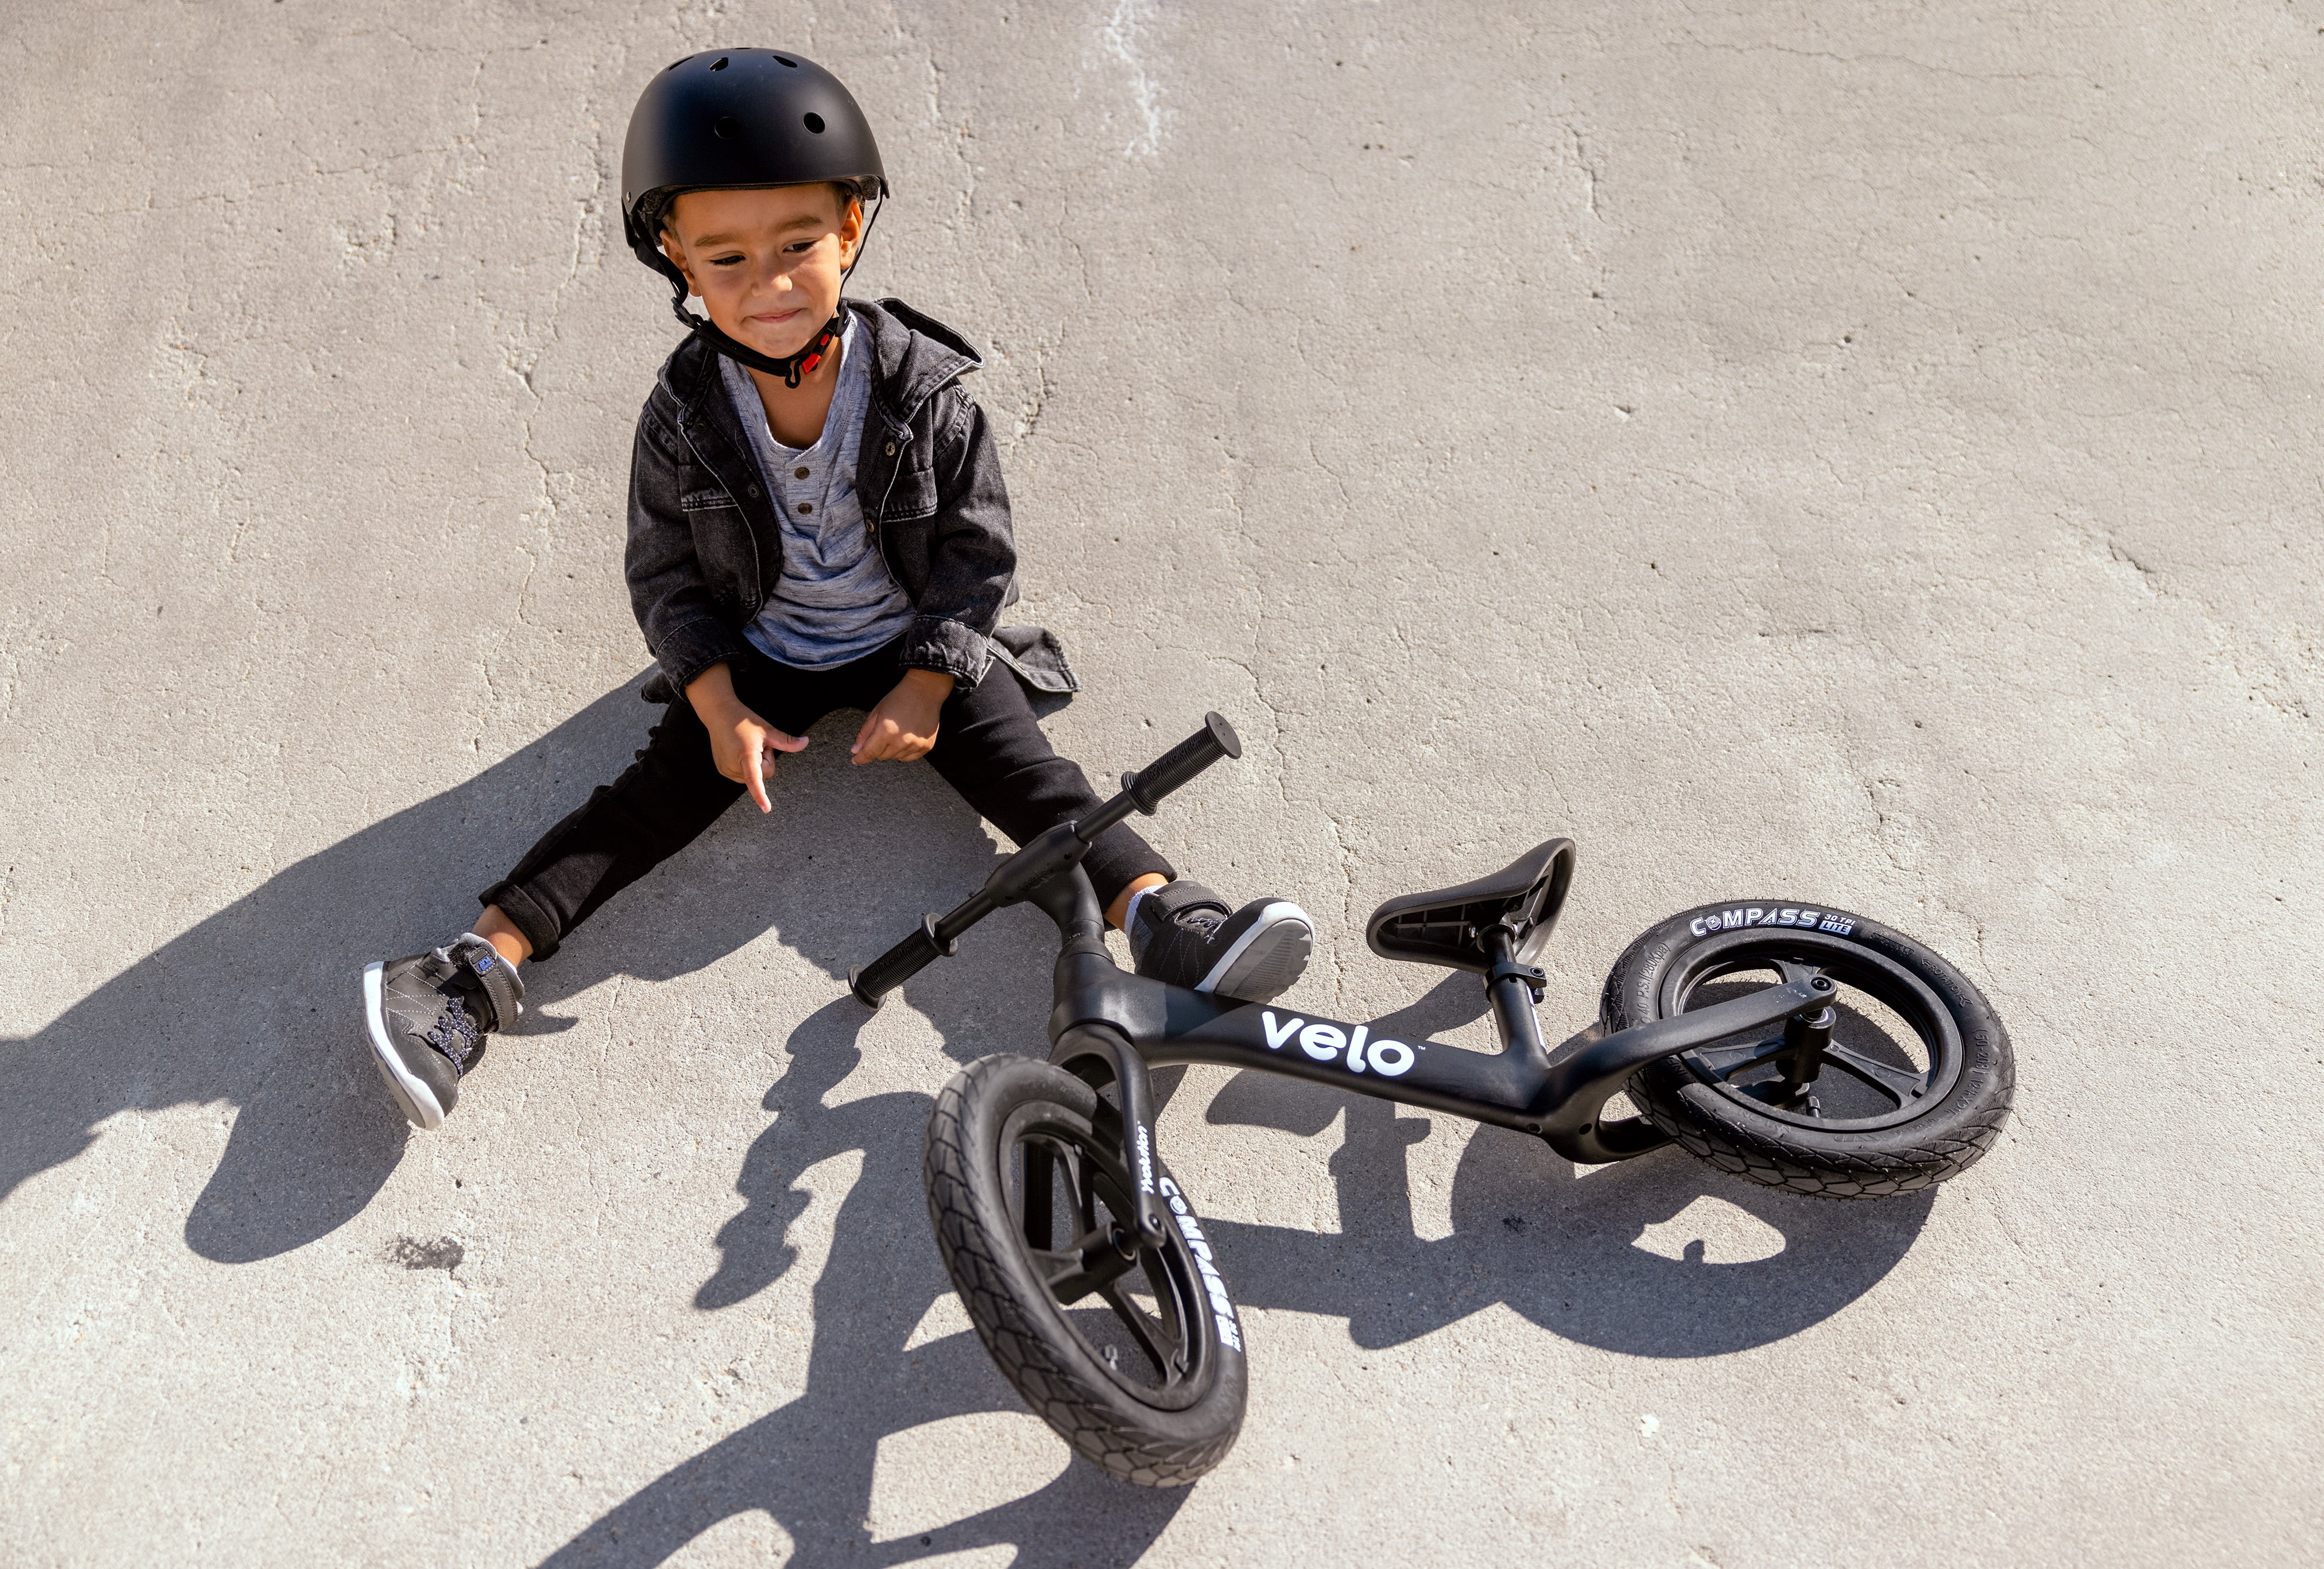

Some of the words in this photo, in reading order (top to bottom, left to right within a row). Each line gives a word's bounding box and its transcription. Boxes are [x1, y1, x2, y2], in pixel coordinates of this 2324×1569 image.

[1822, 921, 1849, 933] LITE
[1839, 916, 1857, 926] TPI
[1928, 965, 1964, 998] ROTATION
[1637, 1003, 1650, 1015] 40
[1261, 1010, 1415, 1077] velo
